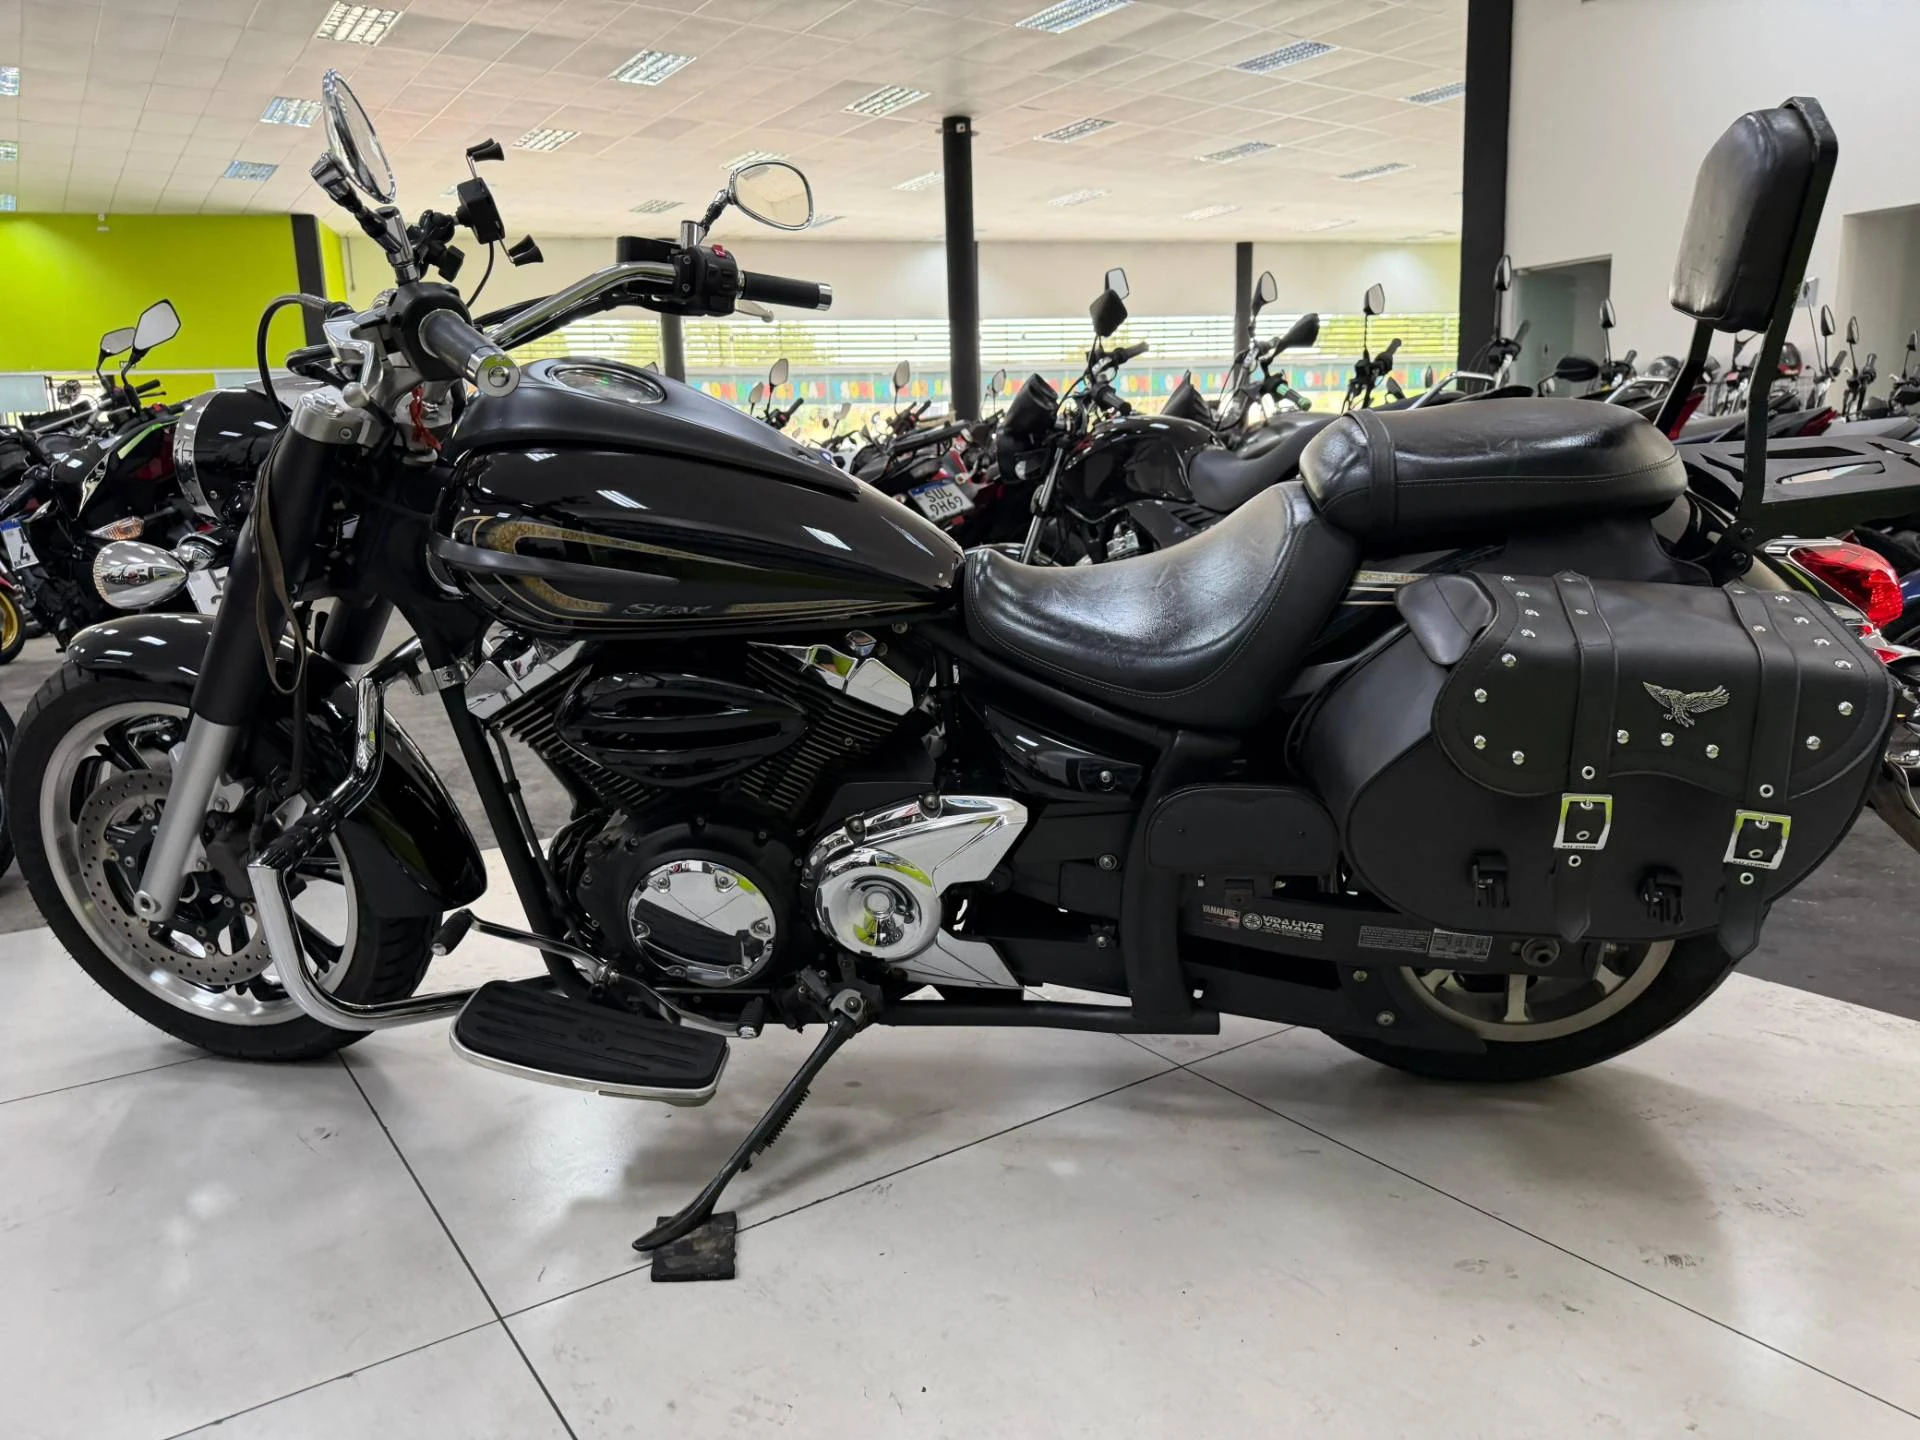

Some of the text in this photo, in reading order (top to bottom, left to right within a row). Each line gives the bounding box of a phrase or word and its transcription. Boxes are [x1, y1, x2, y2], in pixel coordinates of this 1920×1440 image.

[924, 487, 953, 503] SUL
[929, 496, 964, 516] 9H69
[621, 602, 713, 616] Star
[1202, 903, 1239, 918] YAMALUBE
[1263, 922, 1322, 934] YAMAHA
